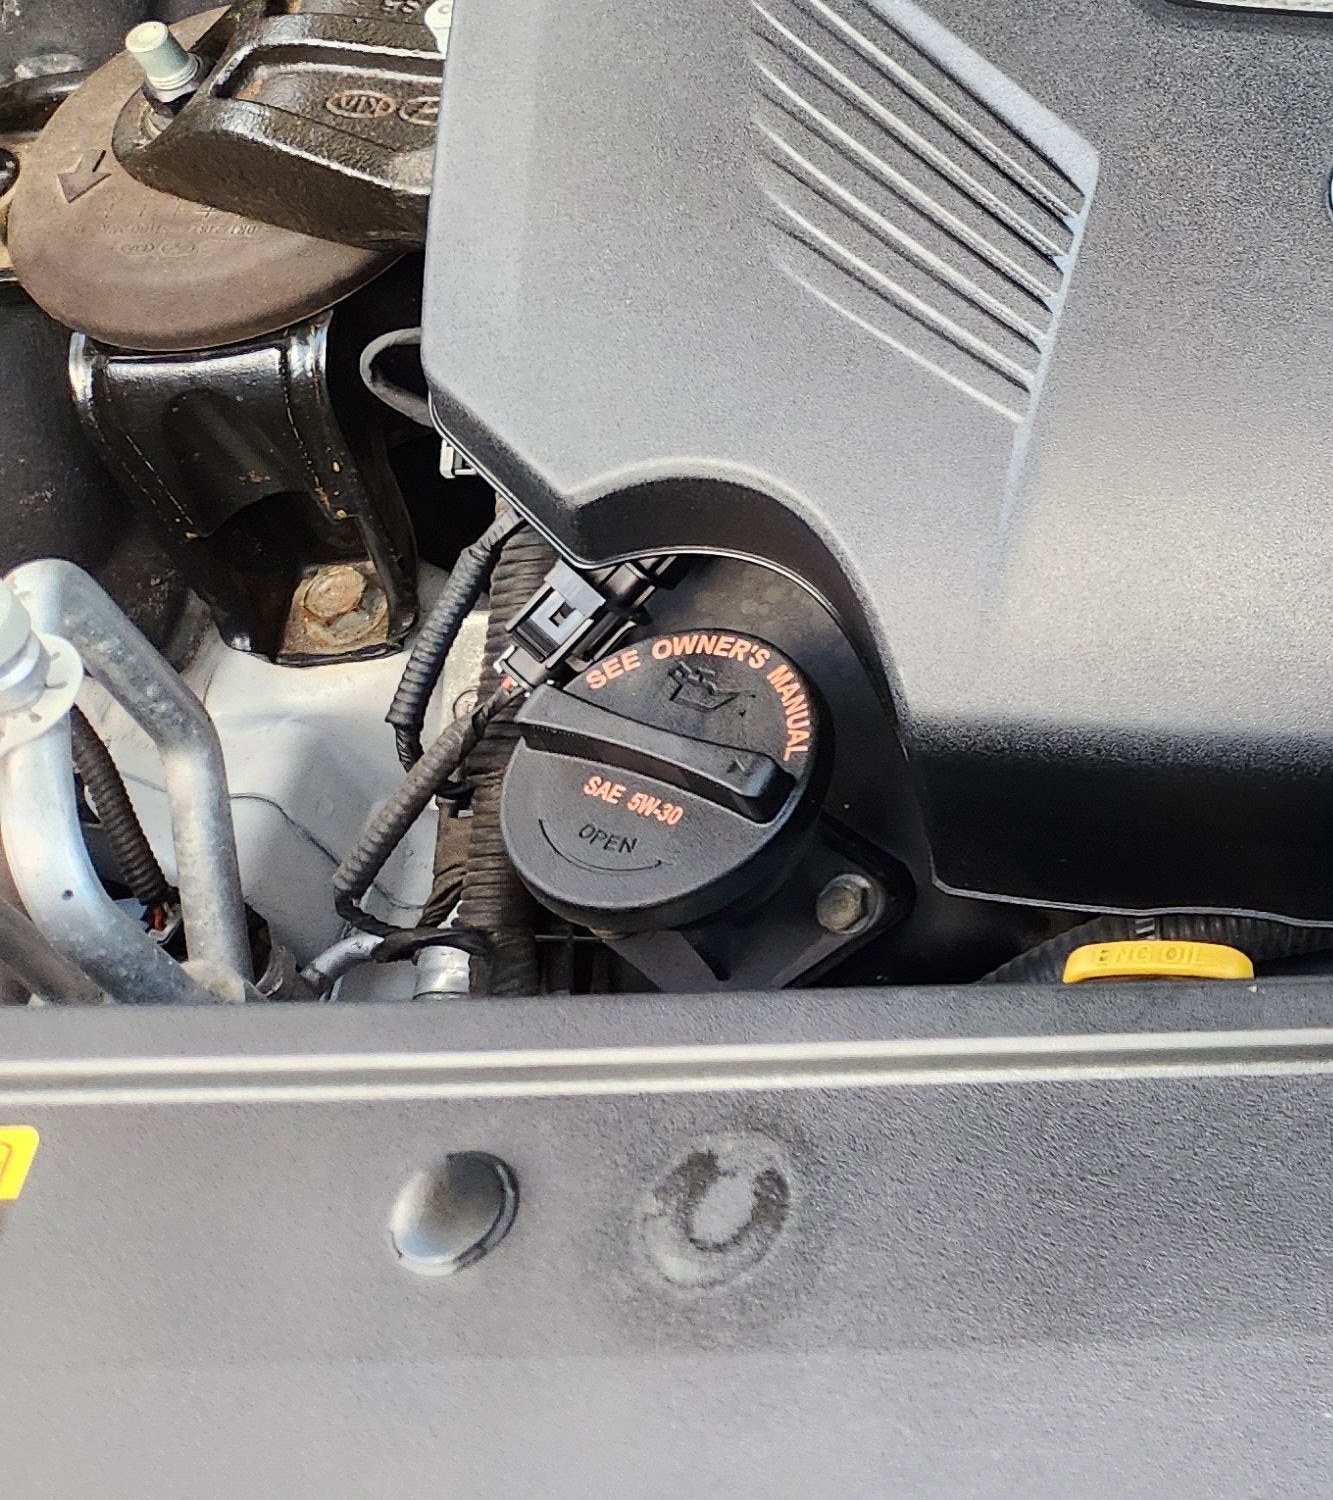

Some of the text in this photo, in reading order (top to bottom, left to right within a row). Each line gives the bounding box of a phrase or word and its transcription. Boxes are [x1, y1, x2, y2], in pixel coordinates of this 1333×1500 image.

[586, 633, 812, 762] SEE OWNER'S MANUAL
[583, 775, 684, 826] SAE 5W-30
[578, 823, 639, 854] OPEN
[1097, 945, 1206, 966] ENG OIL
